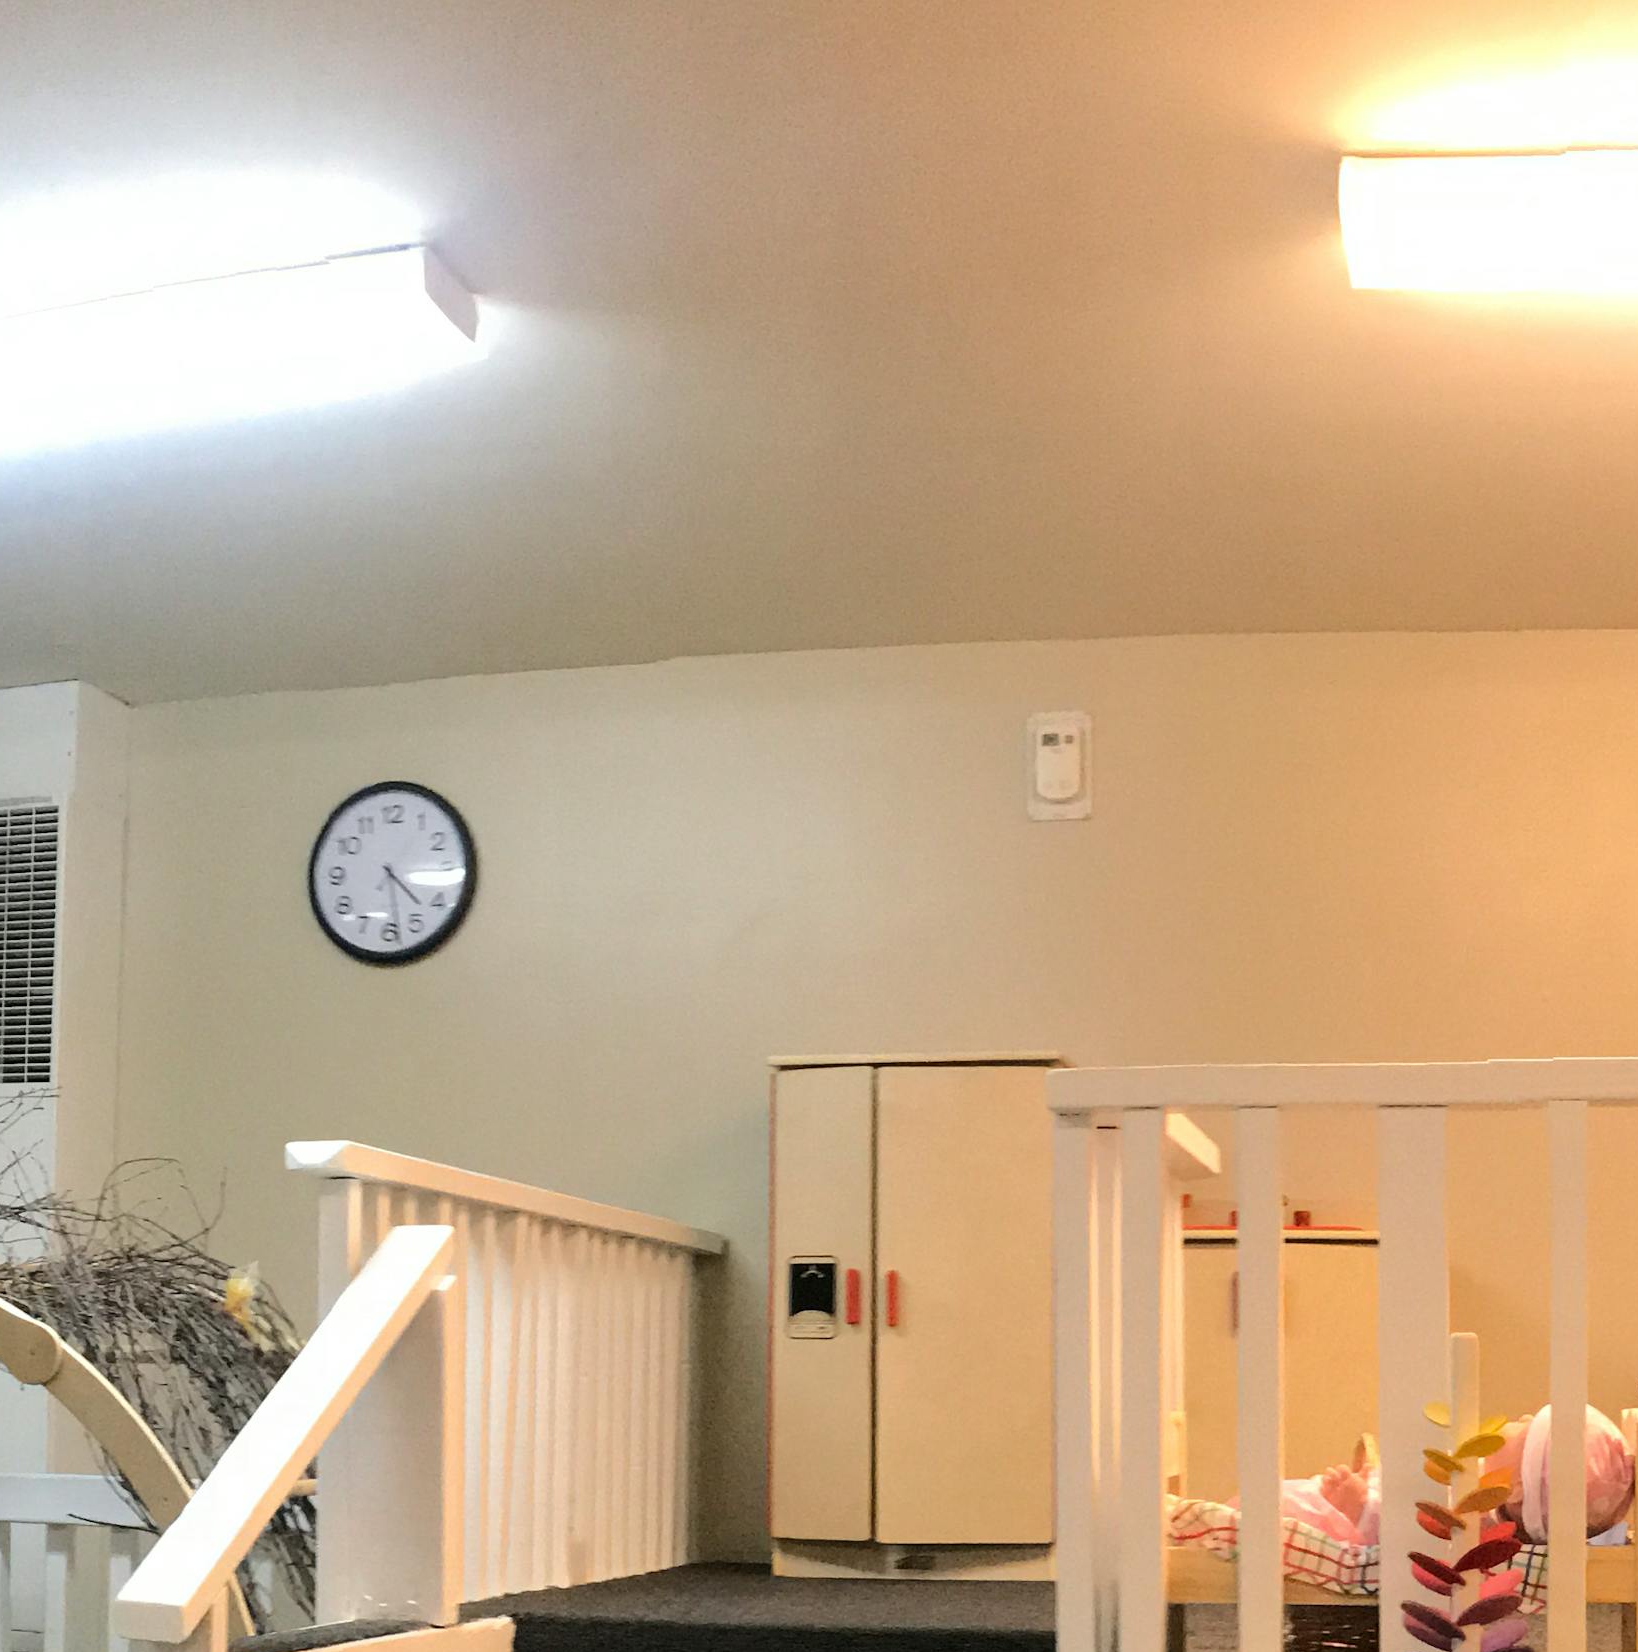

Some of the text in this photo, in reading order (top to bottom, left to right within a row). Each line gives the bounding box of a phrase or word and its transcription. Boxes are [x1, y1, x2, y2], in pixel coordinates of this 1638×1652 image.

[381, 804, 406, 825] 12
[416, 812, 427, 832] 1
[357, 815, 374, 835] 11
[337, 836, 362, 856] 10
[430, 831, 446, 851] 2
[329, 866, 346, 886] 9
[334, 895, 353, 915] 8
[430, 891, 445, 910] 4
[358, 914, 372, 935] 7
[379, 922, 399, 943] 6
[408, 912, 424, 933] 5
